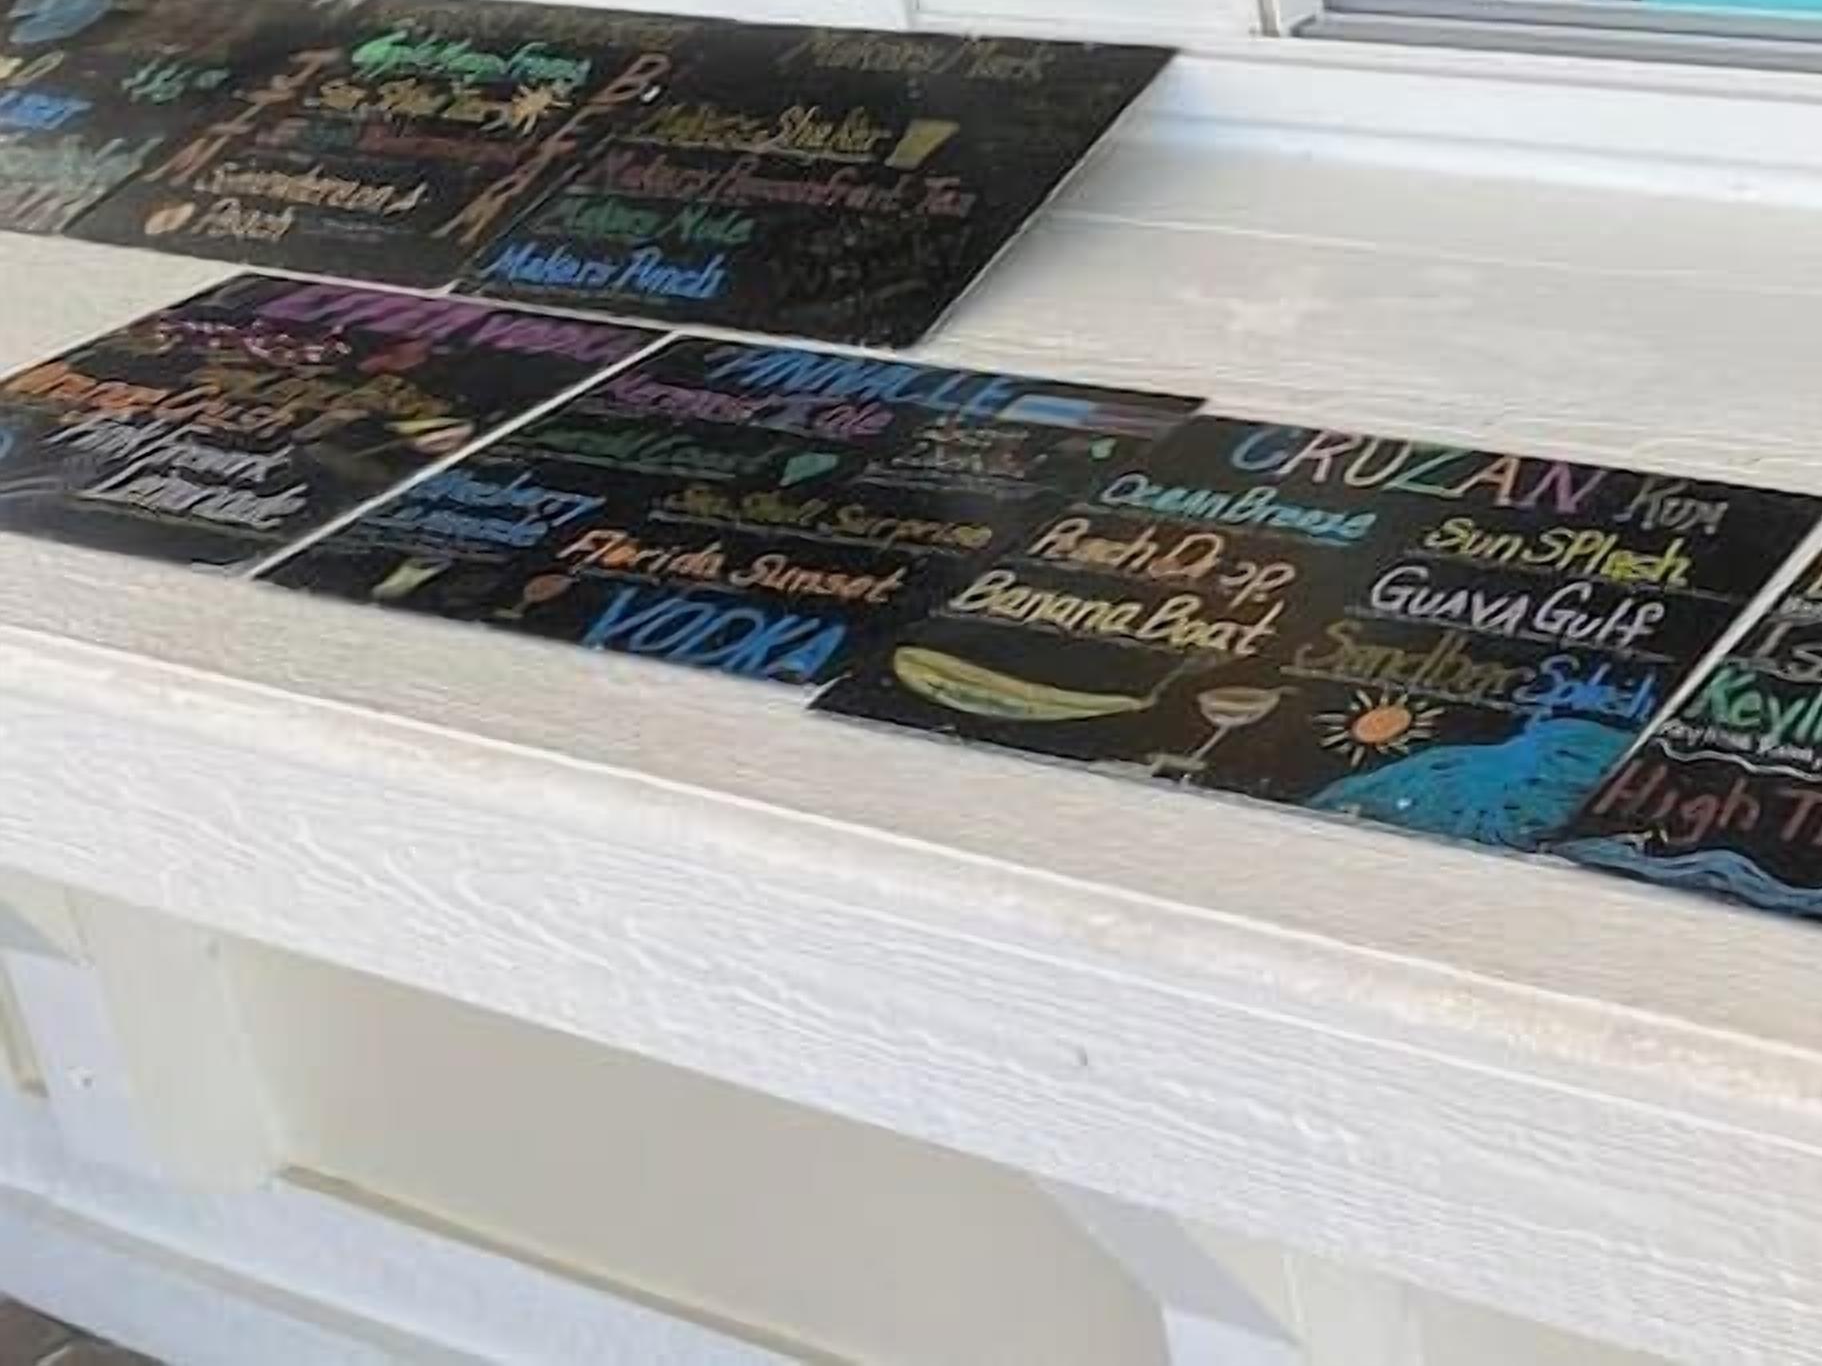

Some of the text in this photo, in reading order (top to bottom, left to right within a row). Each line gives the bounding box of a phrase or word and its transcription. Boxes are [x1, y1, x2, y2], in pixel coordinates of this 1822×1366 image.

[1227, 429, 1607, 516] CRUZAN
[556, 530, 909, 602] Florida Sunset
[584, 584, 848, 676] VODKA
